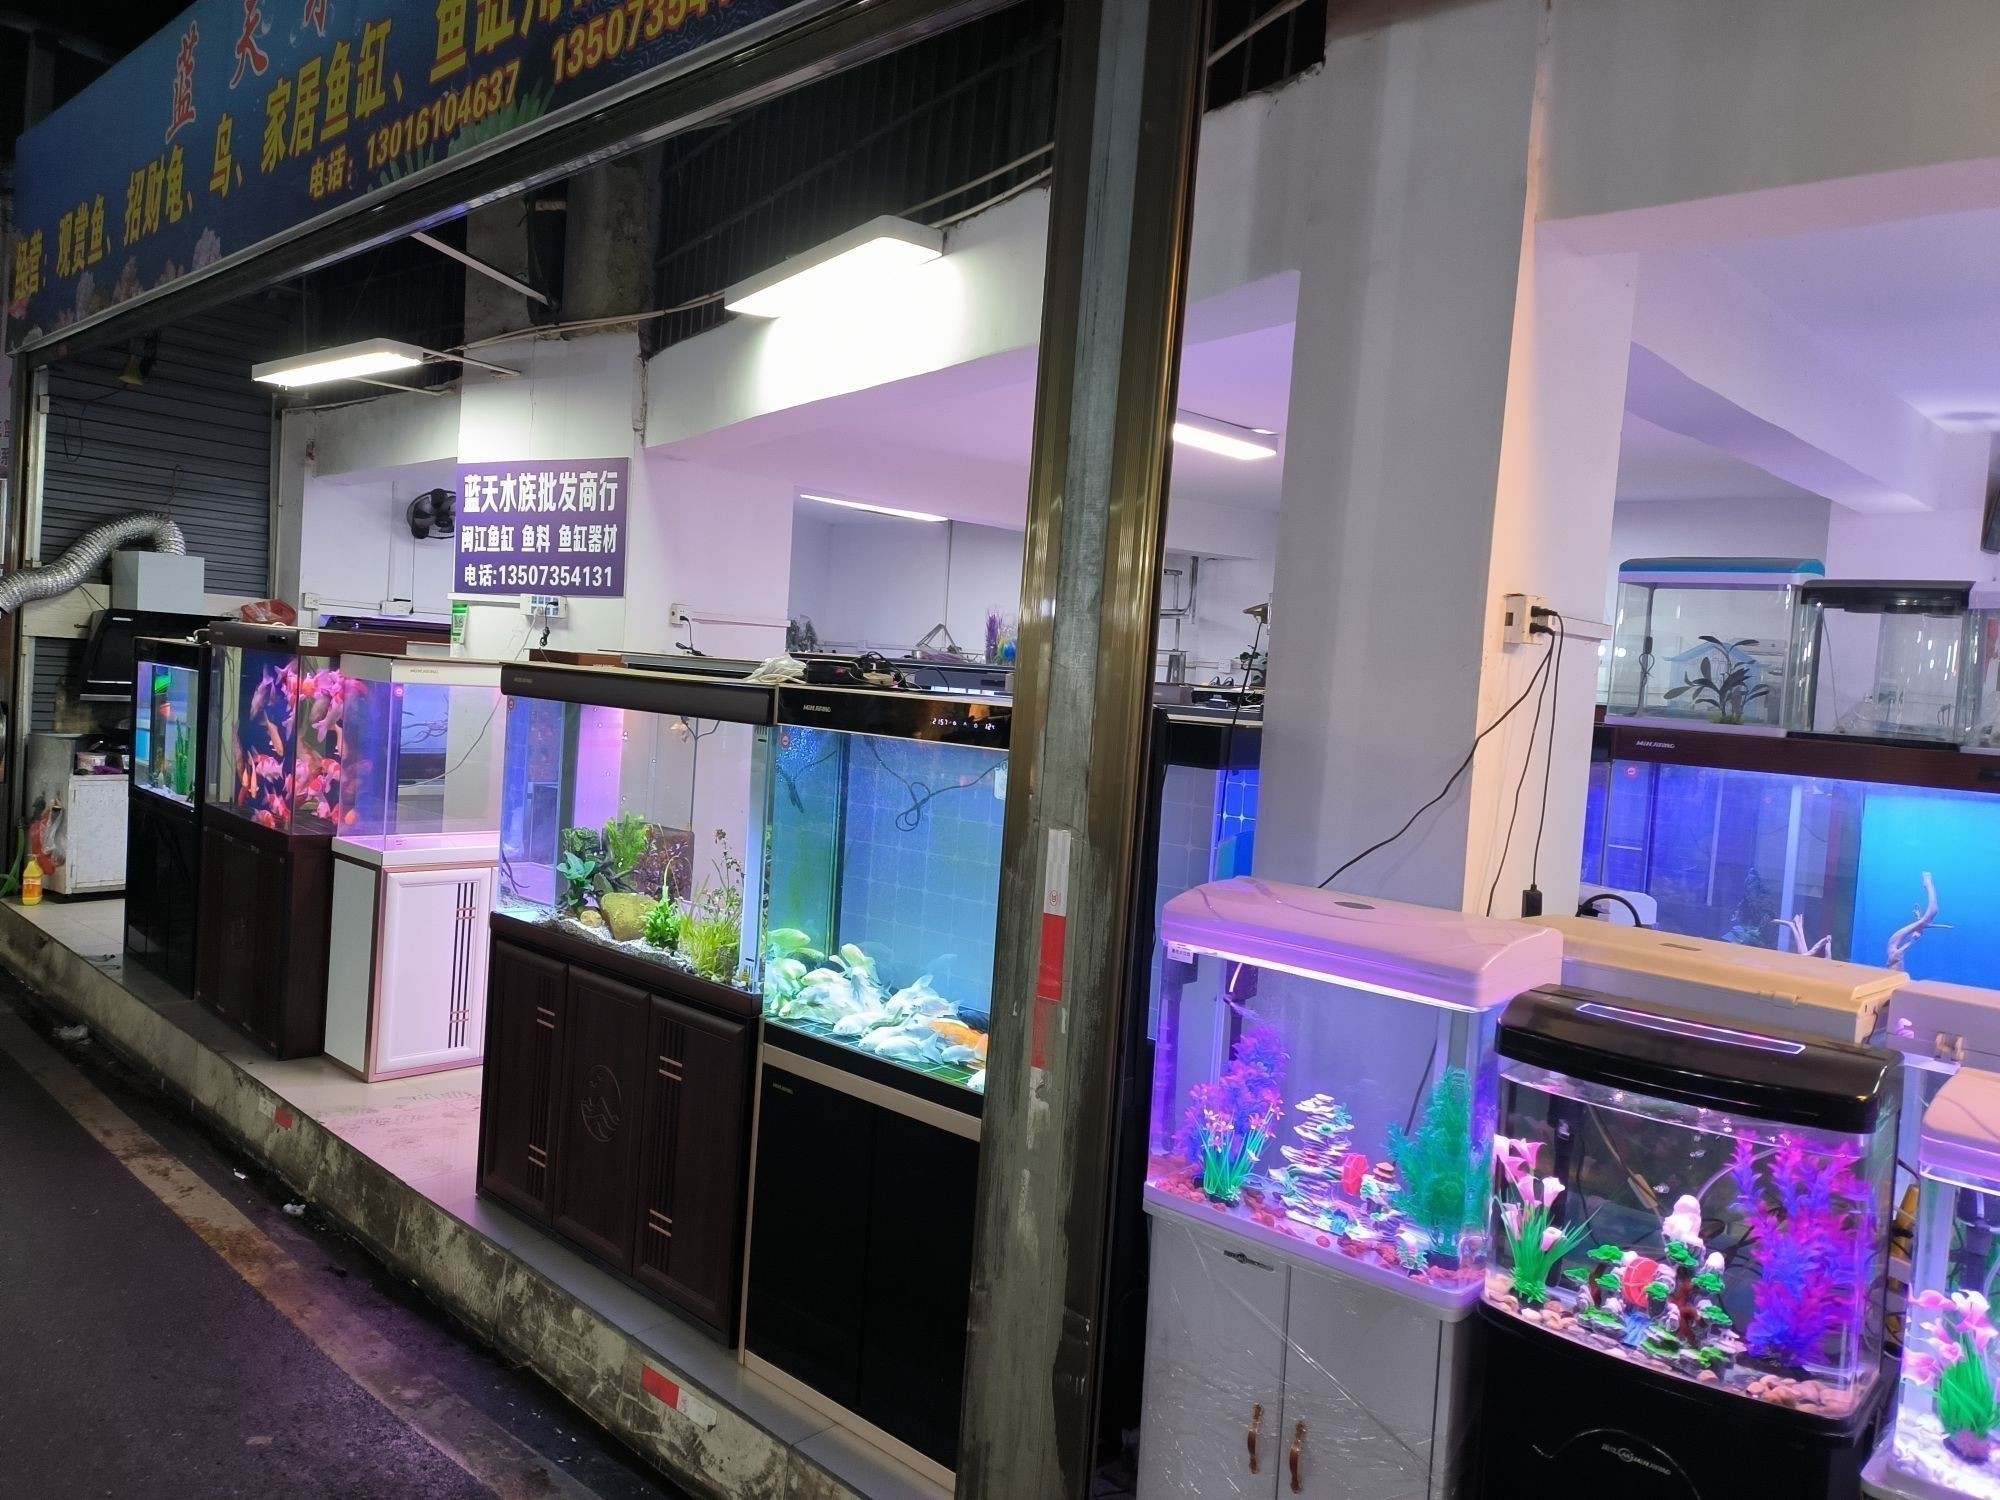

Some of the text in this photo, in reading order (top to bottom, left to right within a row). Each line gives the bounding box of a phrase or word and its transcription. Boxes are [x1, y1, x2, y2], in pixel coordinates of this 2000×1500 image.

[551, 0, 730, 83] 1350735
[463, 470, 618, 514] 蓝天水族批发商行
[521, 524, 551, 553] 鱼料
[557, 523, 618, 554] 鱼缸器材
